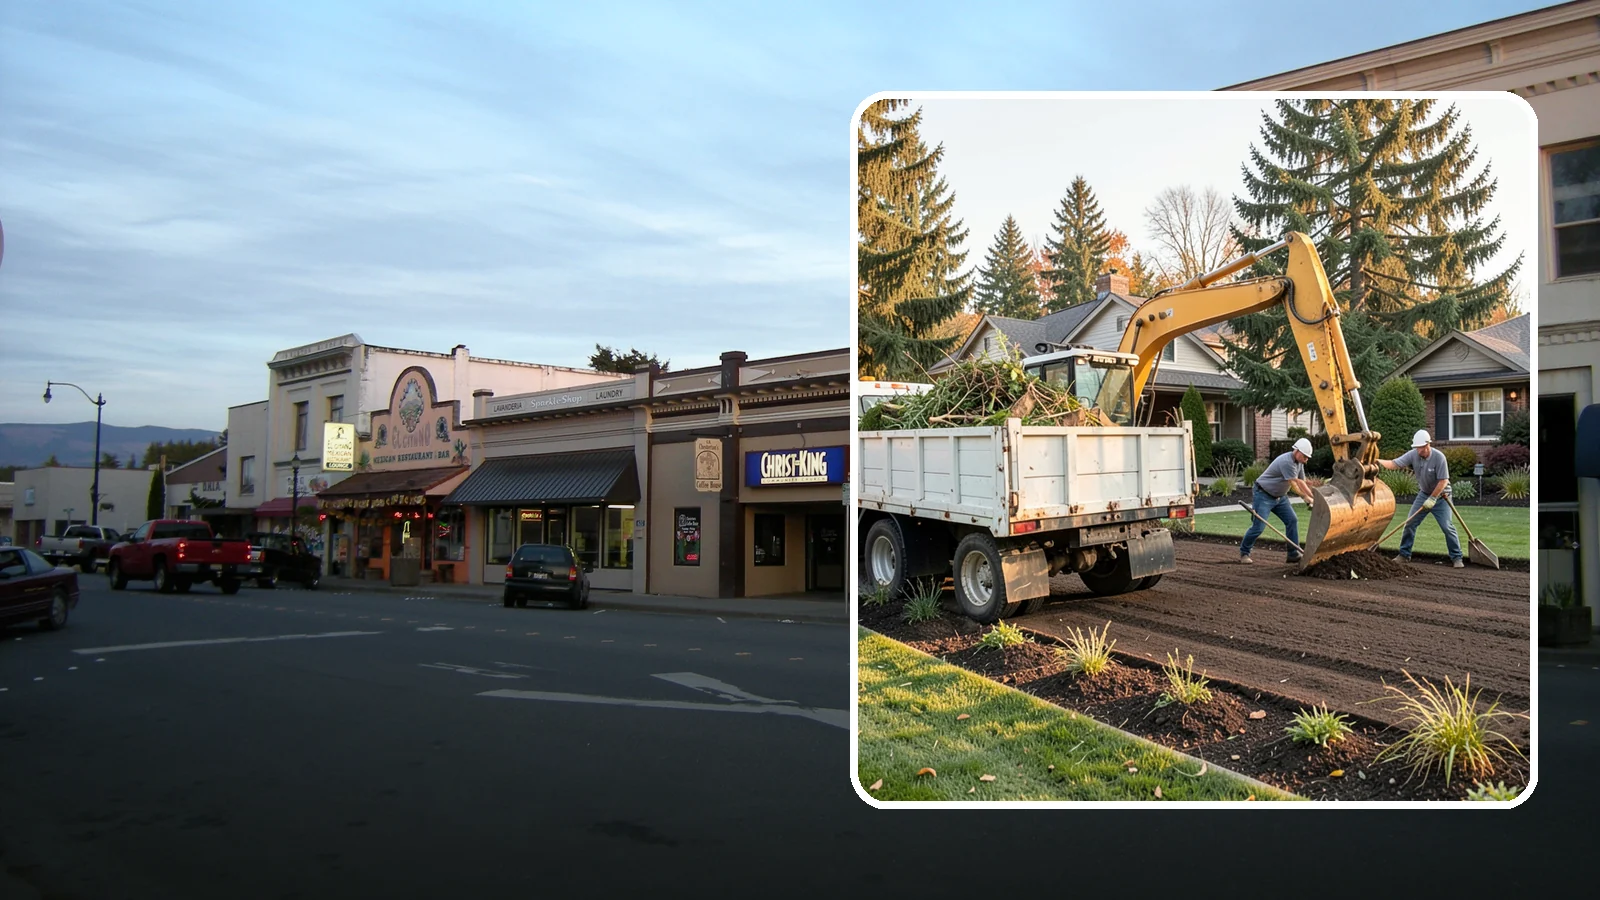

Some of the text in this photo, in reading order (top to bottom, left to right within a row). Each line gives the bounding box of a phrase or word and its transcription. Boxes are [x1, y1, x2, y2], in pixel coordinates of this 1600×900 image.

[595, 389, 624, 400] LAUNDRY
[493, 401, 523, 413] LAVANDERIA
[391, 424, 402, 449] EL
[373, 455, 396, 464] MEXICAN
[397, 451, 433, 462] RESTAURANT
[437, 450, 450, 459] BAR
[760, 450, 828, 478] CHRIST KING
